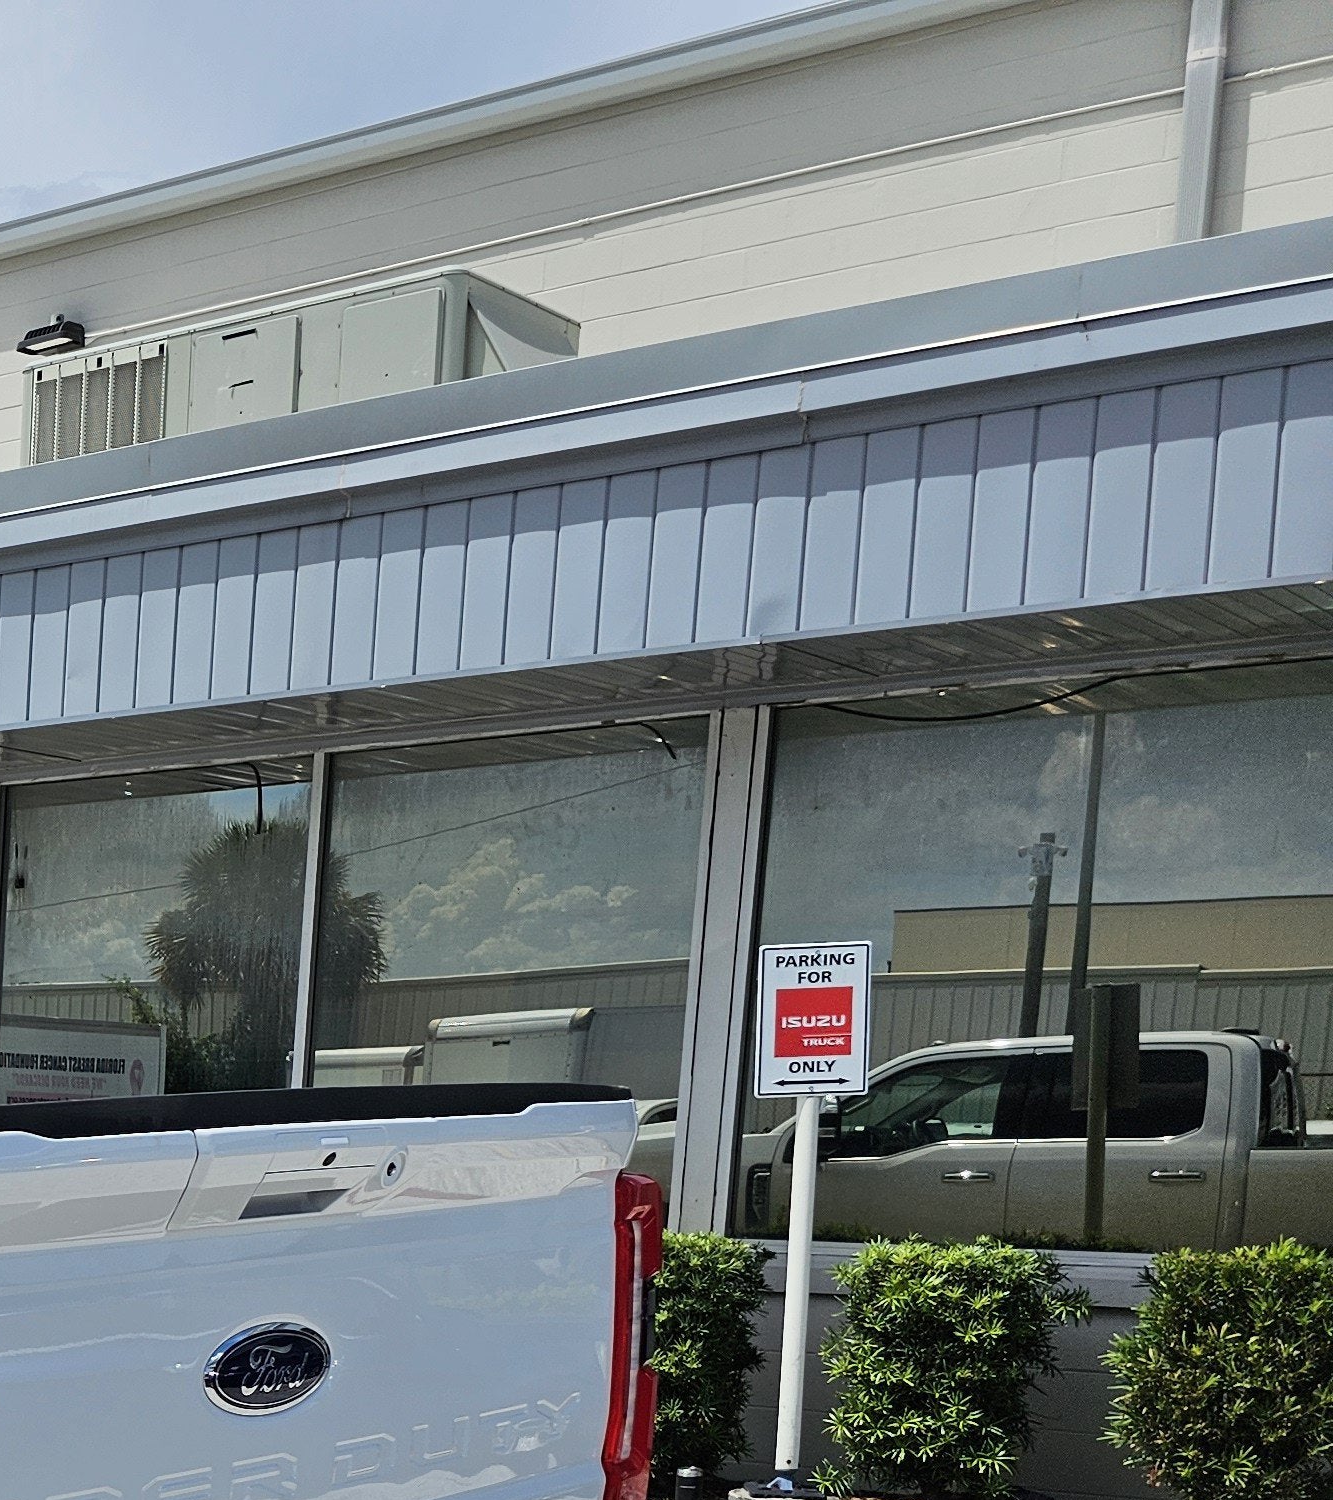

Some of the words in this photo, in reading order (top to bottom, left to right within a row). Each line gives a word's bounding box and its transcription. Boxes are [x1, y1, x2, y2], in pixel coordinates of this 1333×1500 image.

[775, 952, 856, 968] PARKING
[797, 970, 832, 984] FOR
[781, 1014, 846, 1029] ISUZU
[802, 1036, 845, 1047] TRUCK
[788, 1059, 837, 1074] ONLY
[241, 1343, 310, 1396] Ford
[332, 1390, 582, 1485] DUTY
